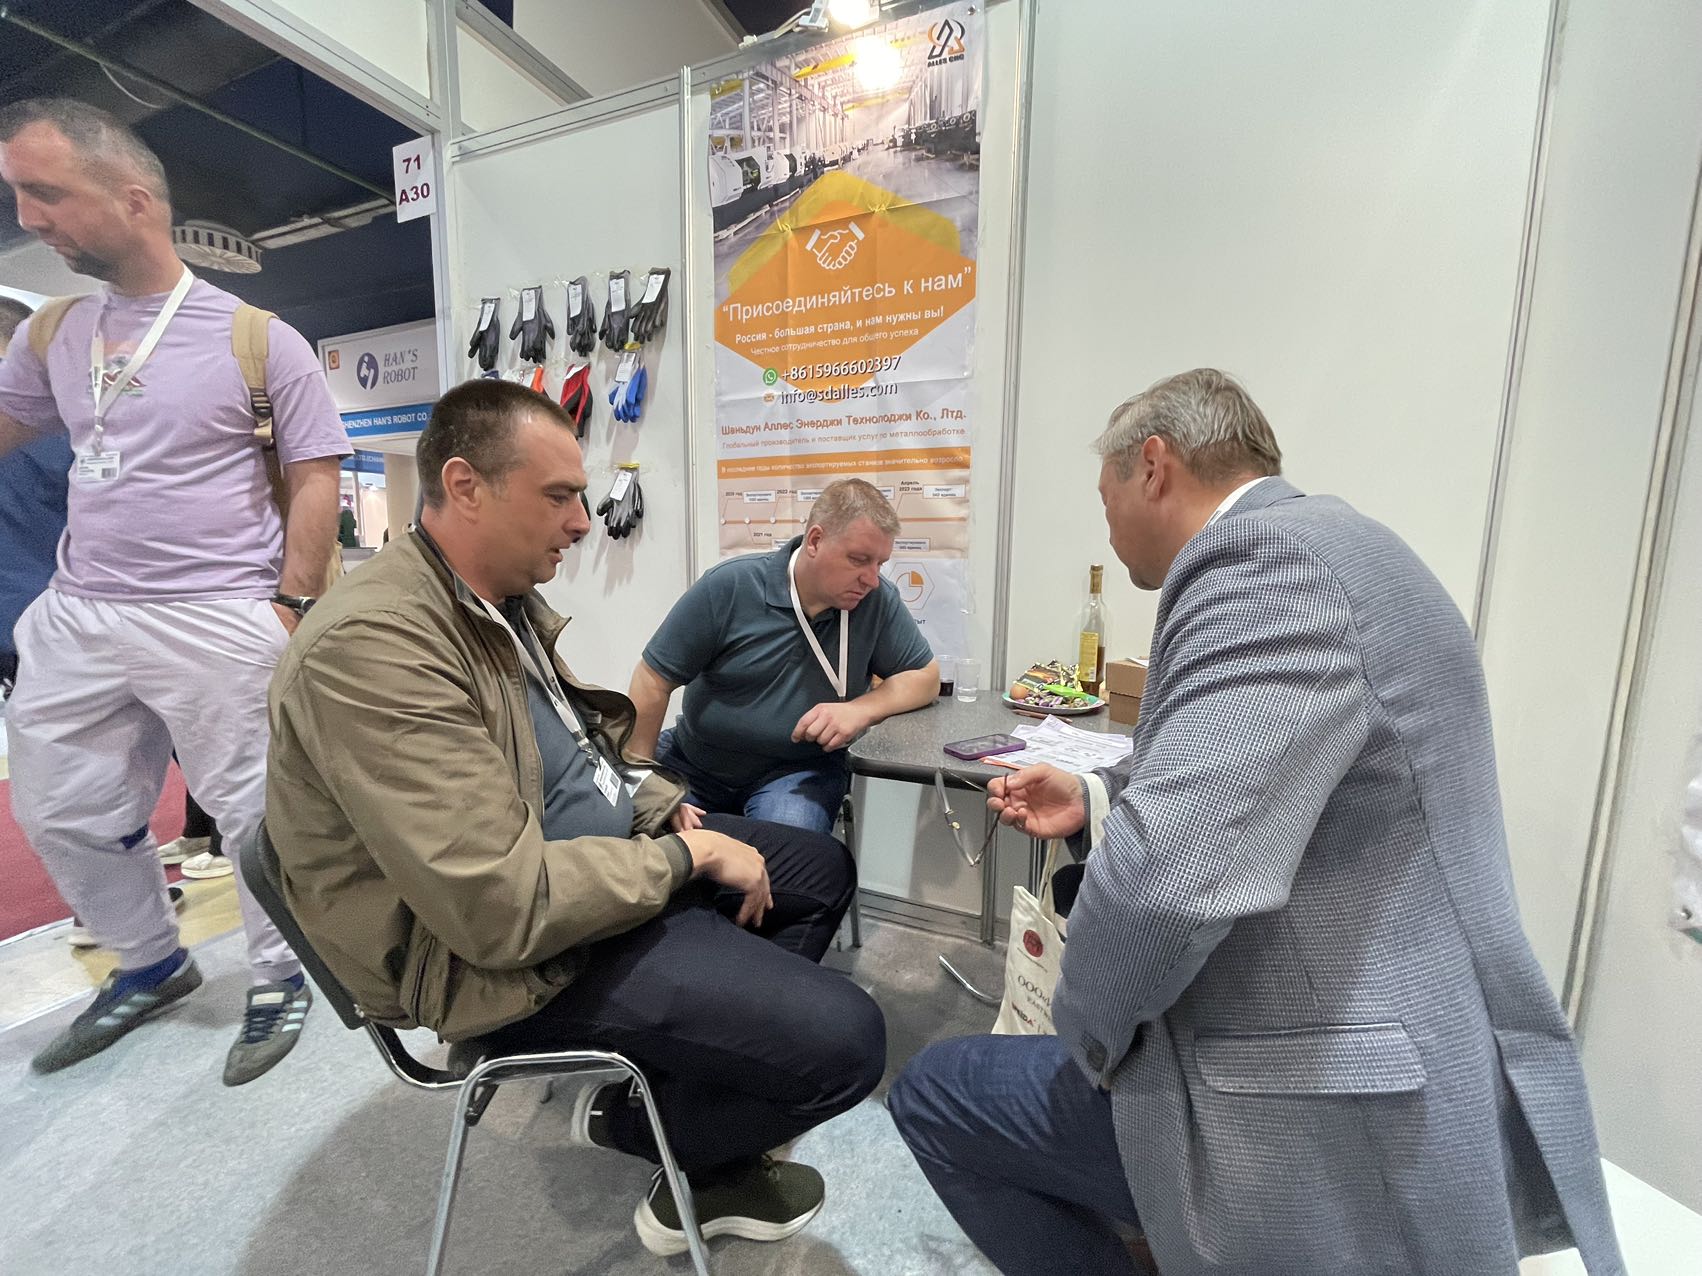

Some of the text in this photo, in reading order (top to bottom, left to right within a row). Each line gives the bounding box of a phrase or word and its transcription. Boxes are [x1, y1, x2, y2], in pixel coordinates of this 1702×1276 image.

[402, 154, 421, 174] 71
[398, 182, 431, 206] A30
[903, 279, 914, 295] к
[735, 332, 767, 345] Россия
[774, 325, 815, 339] большая
[817, 319, 854, 334] страна,
[856, 319, 863, 328] и
[865, 315, 883, 327] нам
[886, 311, 921, 325] нужны
[924, 306, 944, 319] вы!
[750, 327, 919, 356] Честное сотрудничество для общего успеха
[383, 348, 418, 368] HAN'S
[781, 355, 902, 382] +8615966602397
[383, 366, 418, 385] ROBOT
[781, 382, 898, 406] info@sdalles.com
[373, 416, 392, 426] HAN'S
[393, 413, 416, 424] ROBOT
[721, 423, 761, 436] Шаньдун
[763, 420, 793, 432] Аллес
[795, 418, 843, 431] Энерджи
[845, 412, 912, 426] Технолоджи
[940, 408, 967, 420] Лтд.
